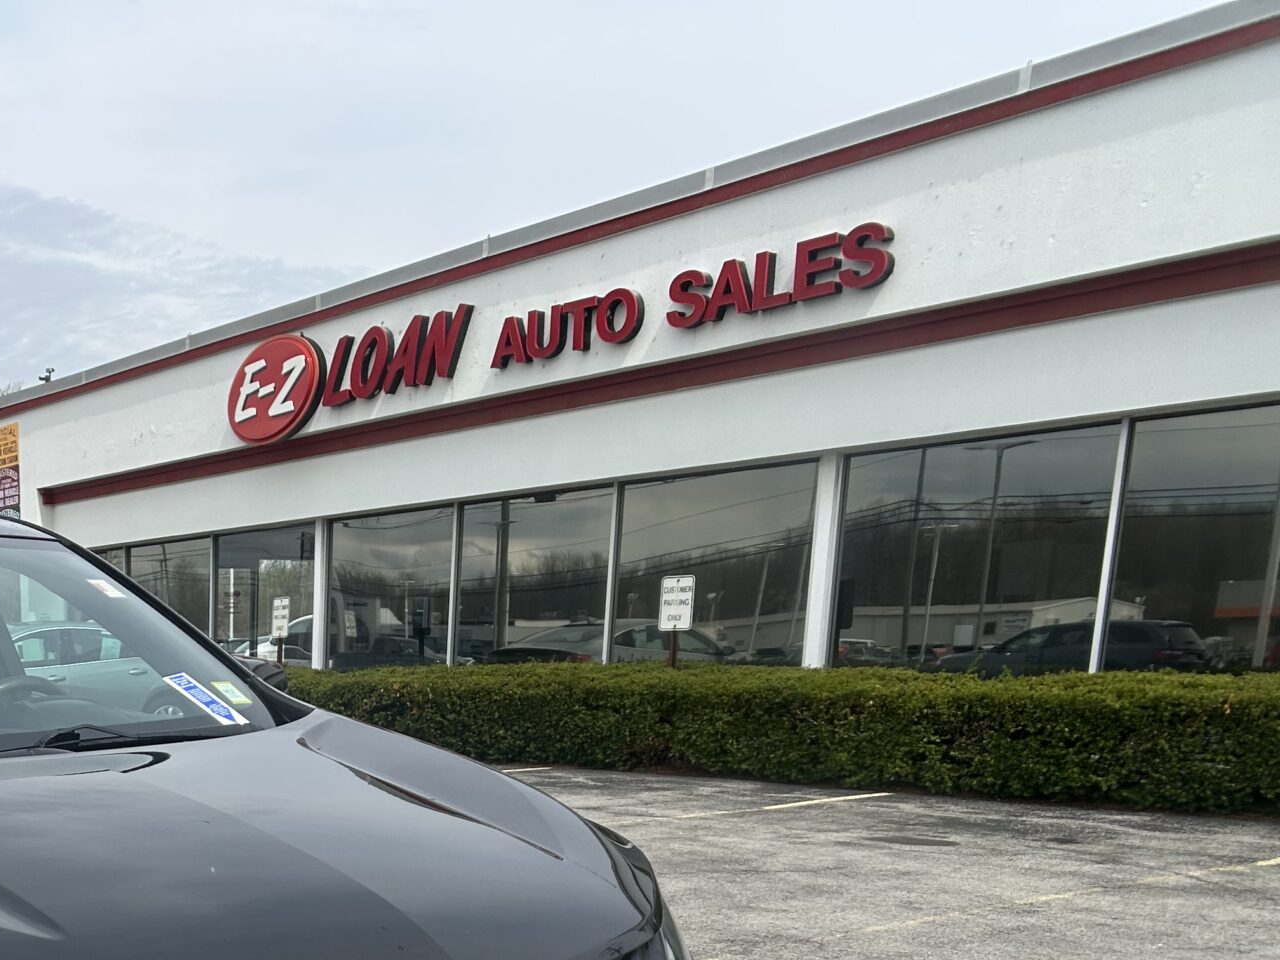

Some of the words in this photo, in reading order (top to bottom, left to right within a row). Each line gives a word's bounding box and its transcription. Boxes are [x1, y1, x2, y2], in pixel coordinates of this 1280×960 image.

[234, 357, 307, 423] E-Z
[322, 303, 475, 409] LOAN
[491, 288, 645, 370] AUTO
[666, 222, 895, 329] SALES
